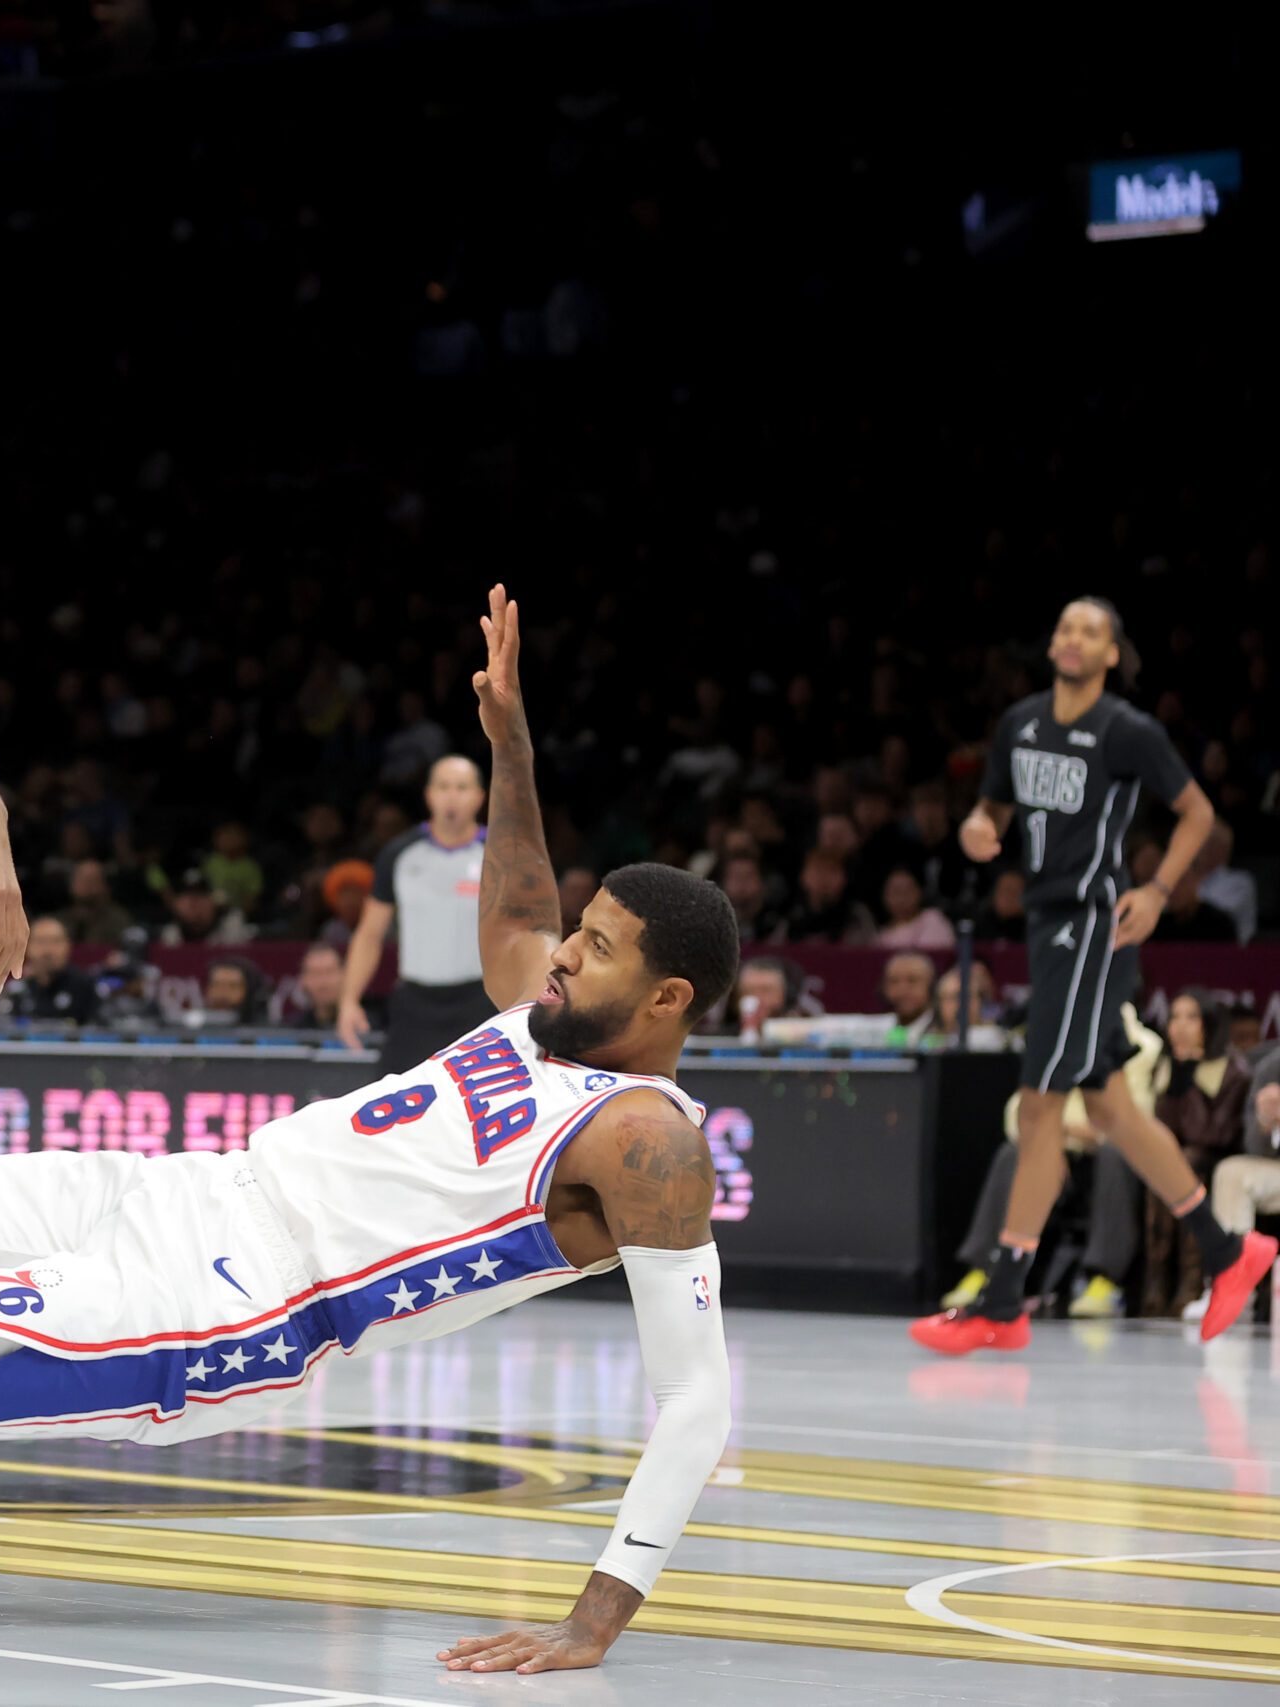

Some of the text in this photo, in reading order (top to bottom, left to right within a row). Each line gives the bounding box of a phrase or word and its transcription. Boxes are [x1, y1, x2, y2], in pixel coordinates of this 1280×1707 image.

[1010, 746, 1088, 815] NETS
[1026, 808, 1048, 874] 1
[351, 1084, 438, 1136] 8
[428, 1026, 538, 1167] PHILA
